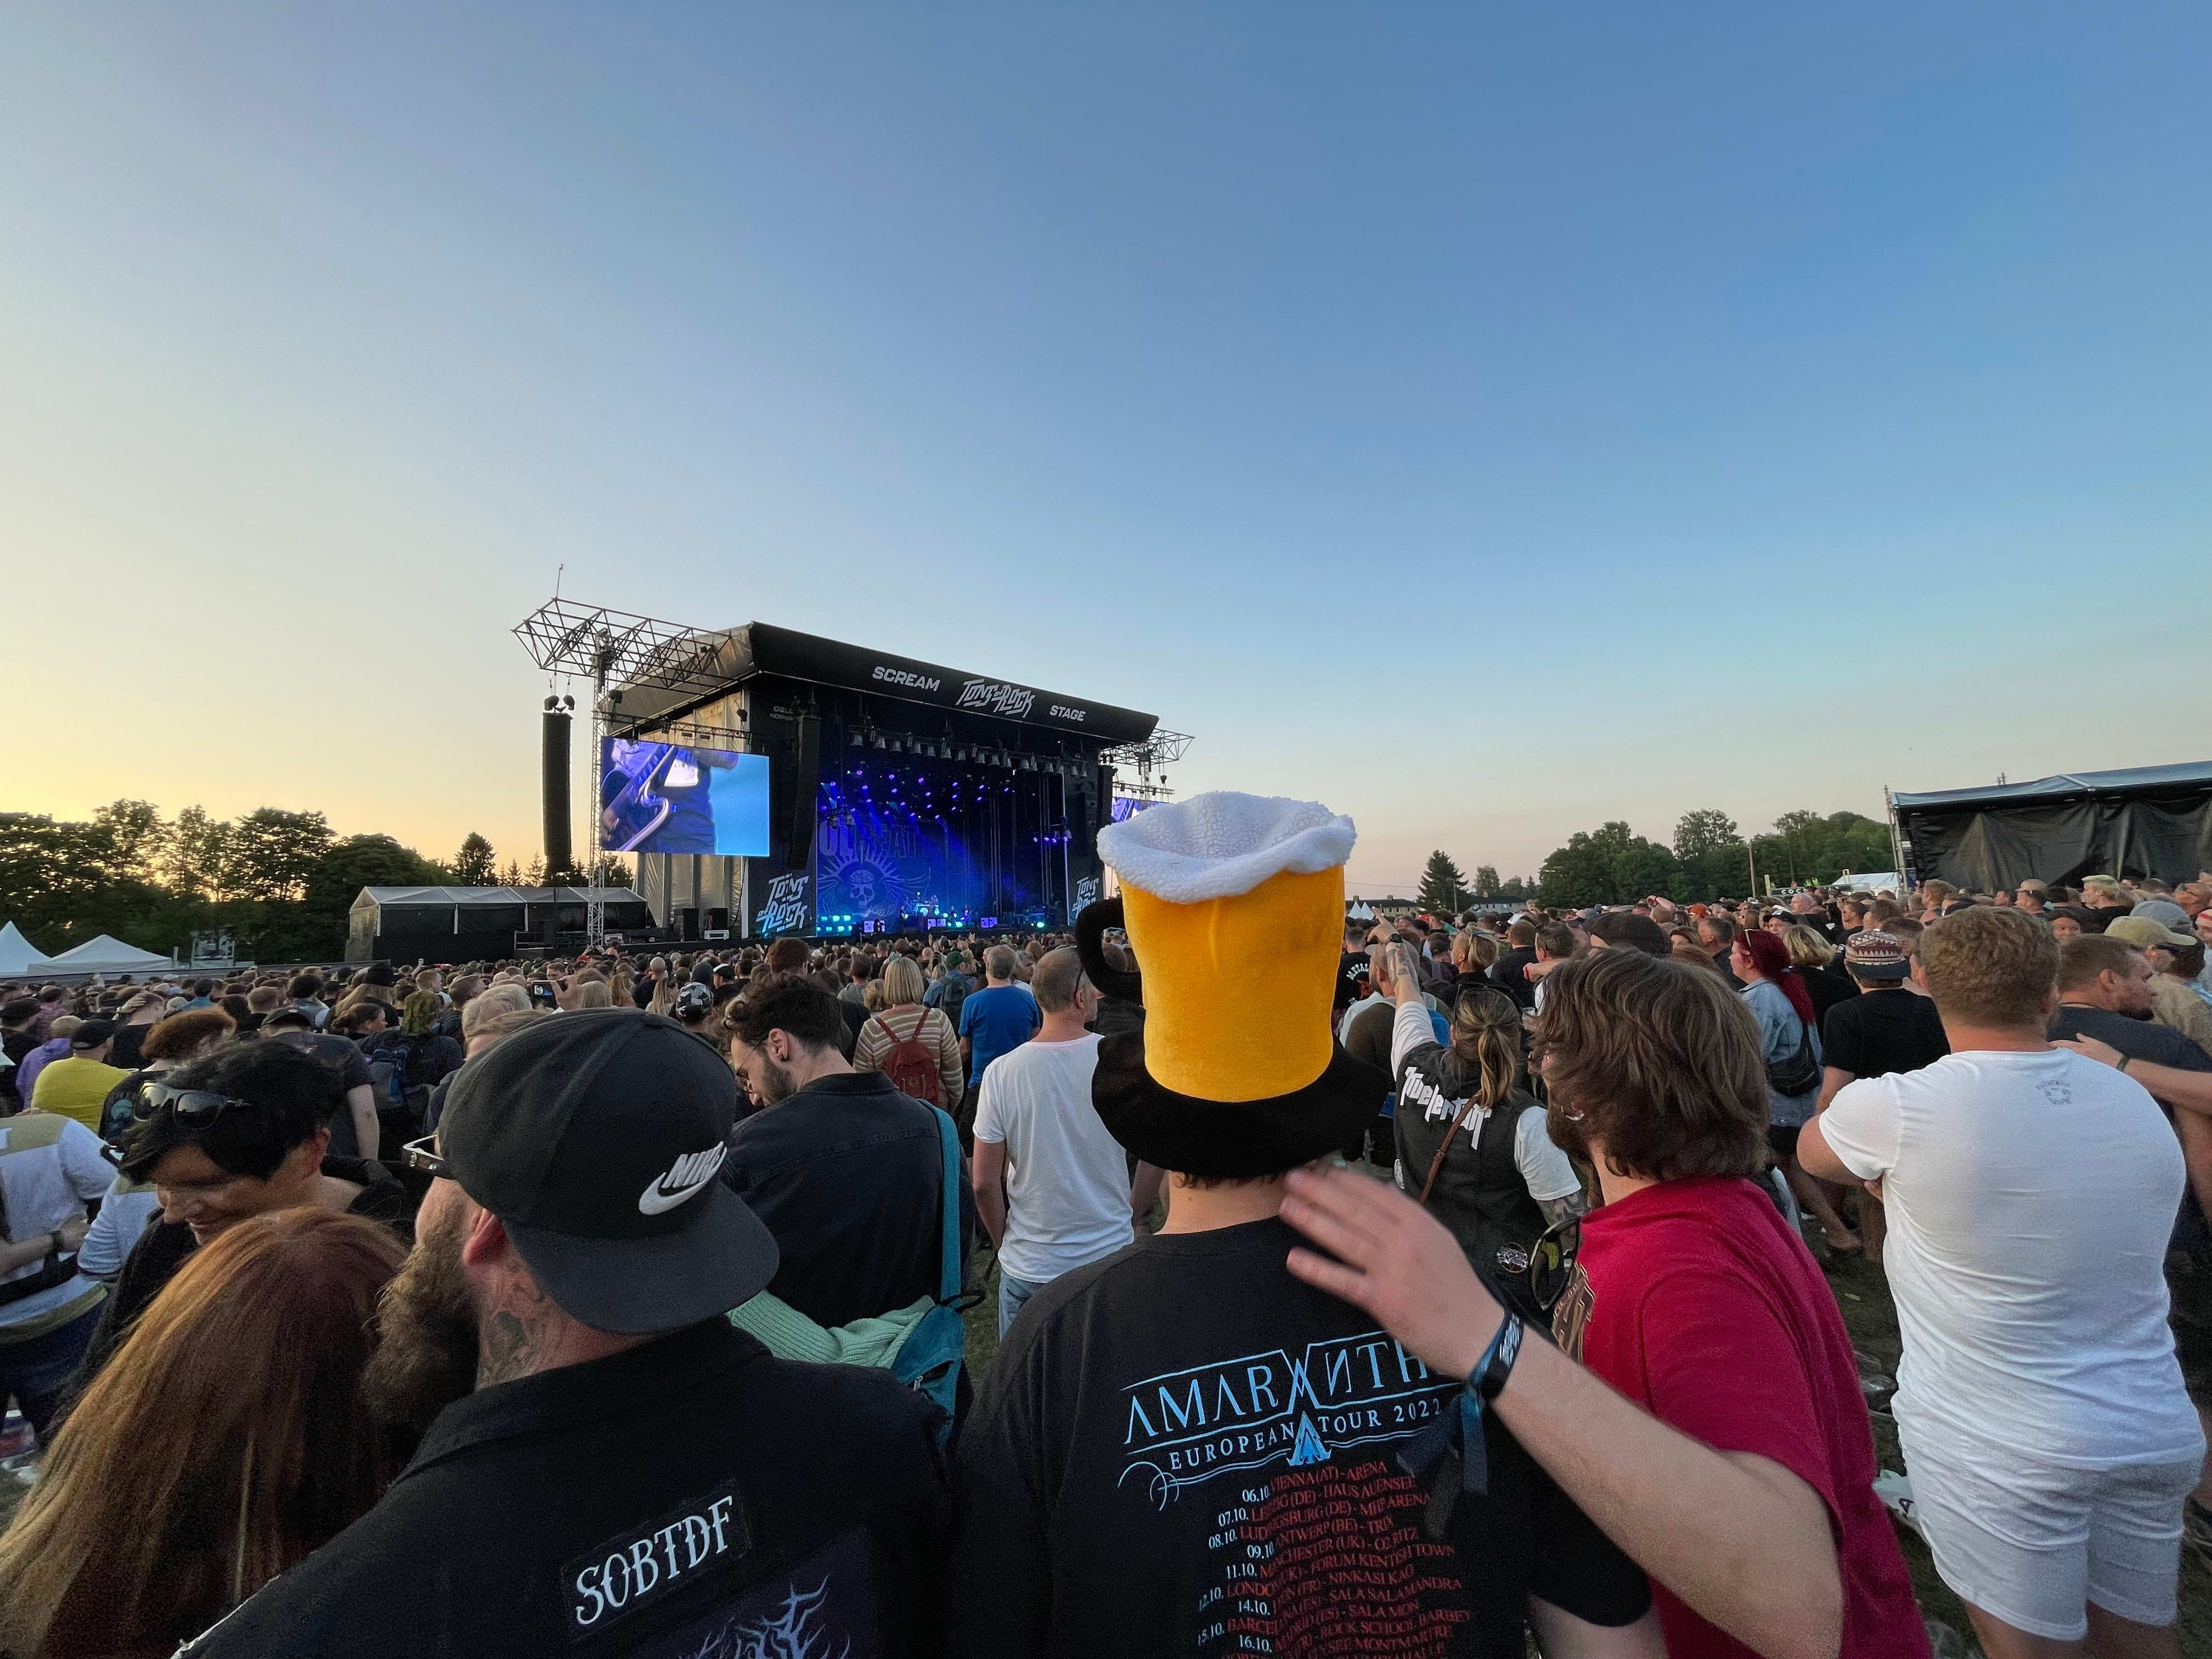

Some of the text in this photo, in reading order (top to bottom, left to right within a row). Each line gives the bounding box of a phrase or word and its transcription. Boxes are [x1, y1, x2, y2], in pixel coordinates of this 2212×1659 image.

[872, 666, 941, 692] SCREAM
[955, 679, 1000, 708] TONS
[993, 684, 1036, 718] ROCK
[1049, 704, 1086, 722] STAGE
[765, 873, 809, 911] TONS
[756, 901, 808, 933] ROCK
[661, 1142, 723, 1189] NIKE
[1125, 1338, 1430, 1445] AMARANTH
[1170, 1397, 1441, 1470] EUROPEAN TOUR 2022
[1346, 1461, 1388, 1481] ARENA
[1209, 1529, 1238, 1549] 08.10.
[1388, 1493, 1430, 1507] ARENA
[1218, 1508, 1249, 1527] 07.10.
[1324, 1482, 1360, 1498] HAUS
[1276, 1521, 1330, 1547] ANTWERP
[576, 1495, 732, 1625] SOBTDF
[1227, 1563, 1257, 1579] 11.10.
[1239, 1600, 1270, 1615] 14.10.
[1239, 1635, 1272, 1653] 16.10.
